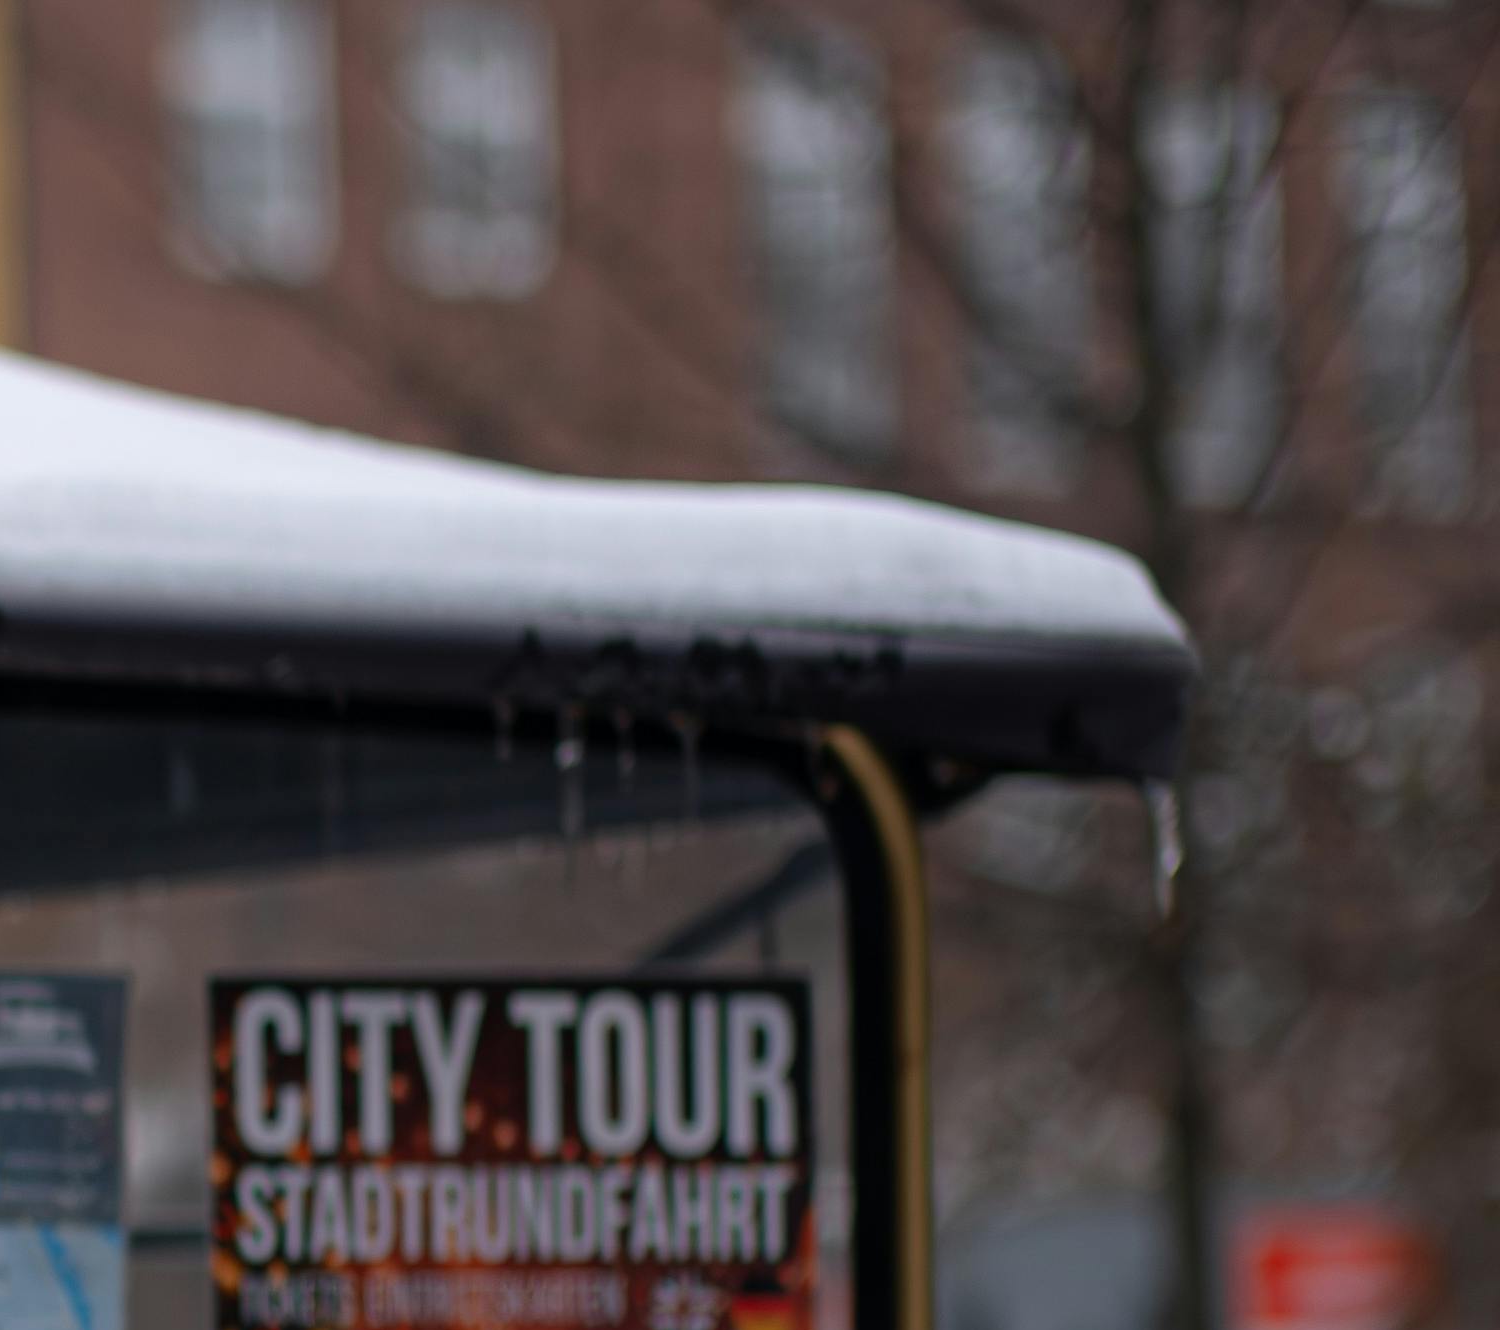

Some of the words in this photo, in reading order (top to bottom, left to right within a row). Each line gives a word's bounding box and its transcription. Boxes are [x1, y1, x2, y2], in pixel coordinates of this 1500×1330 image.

[233, 986, 486, 1158] CITY
[507, 987, 798, 1158] TOUR
[235, 1163, 796, 1264] STADTRUNDFAHRT
